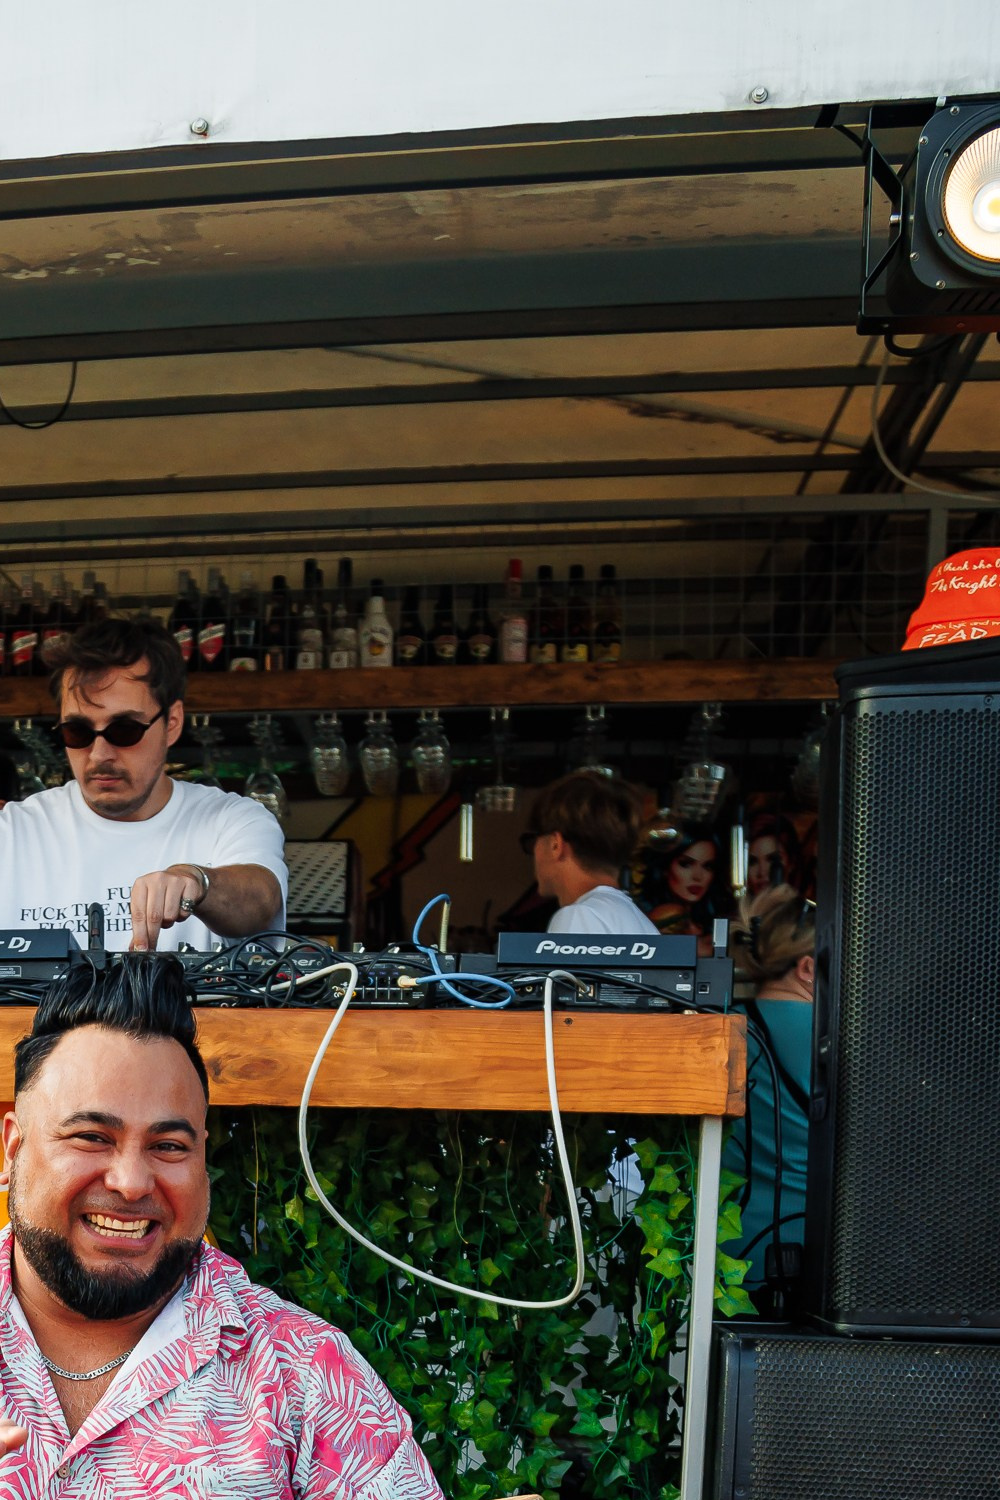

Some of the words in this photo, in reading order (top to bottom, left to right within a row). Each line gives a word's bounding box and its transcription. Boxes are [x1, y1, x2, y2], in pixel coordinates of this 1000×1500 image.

[949, 575, 997, 595] Knight
[20, 906, 68, 921] FUCK
[106, 918, 133, 932] HE
[535, 940, 627, 955] Pioneer
[248, 954, 315, 966] Pioer
